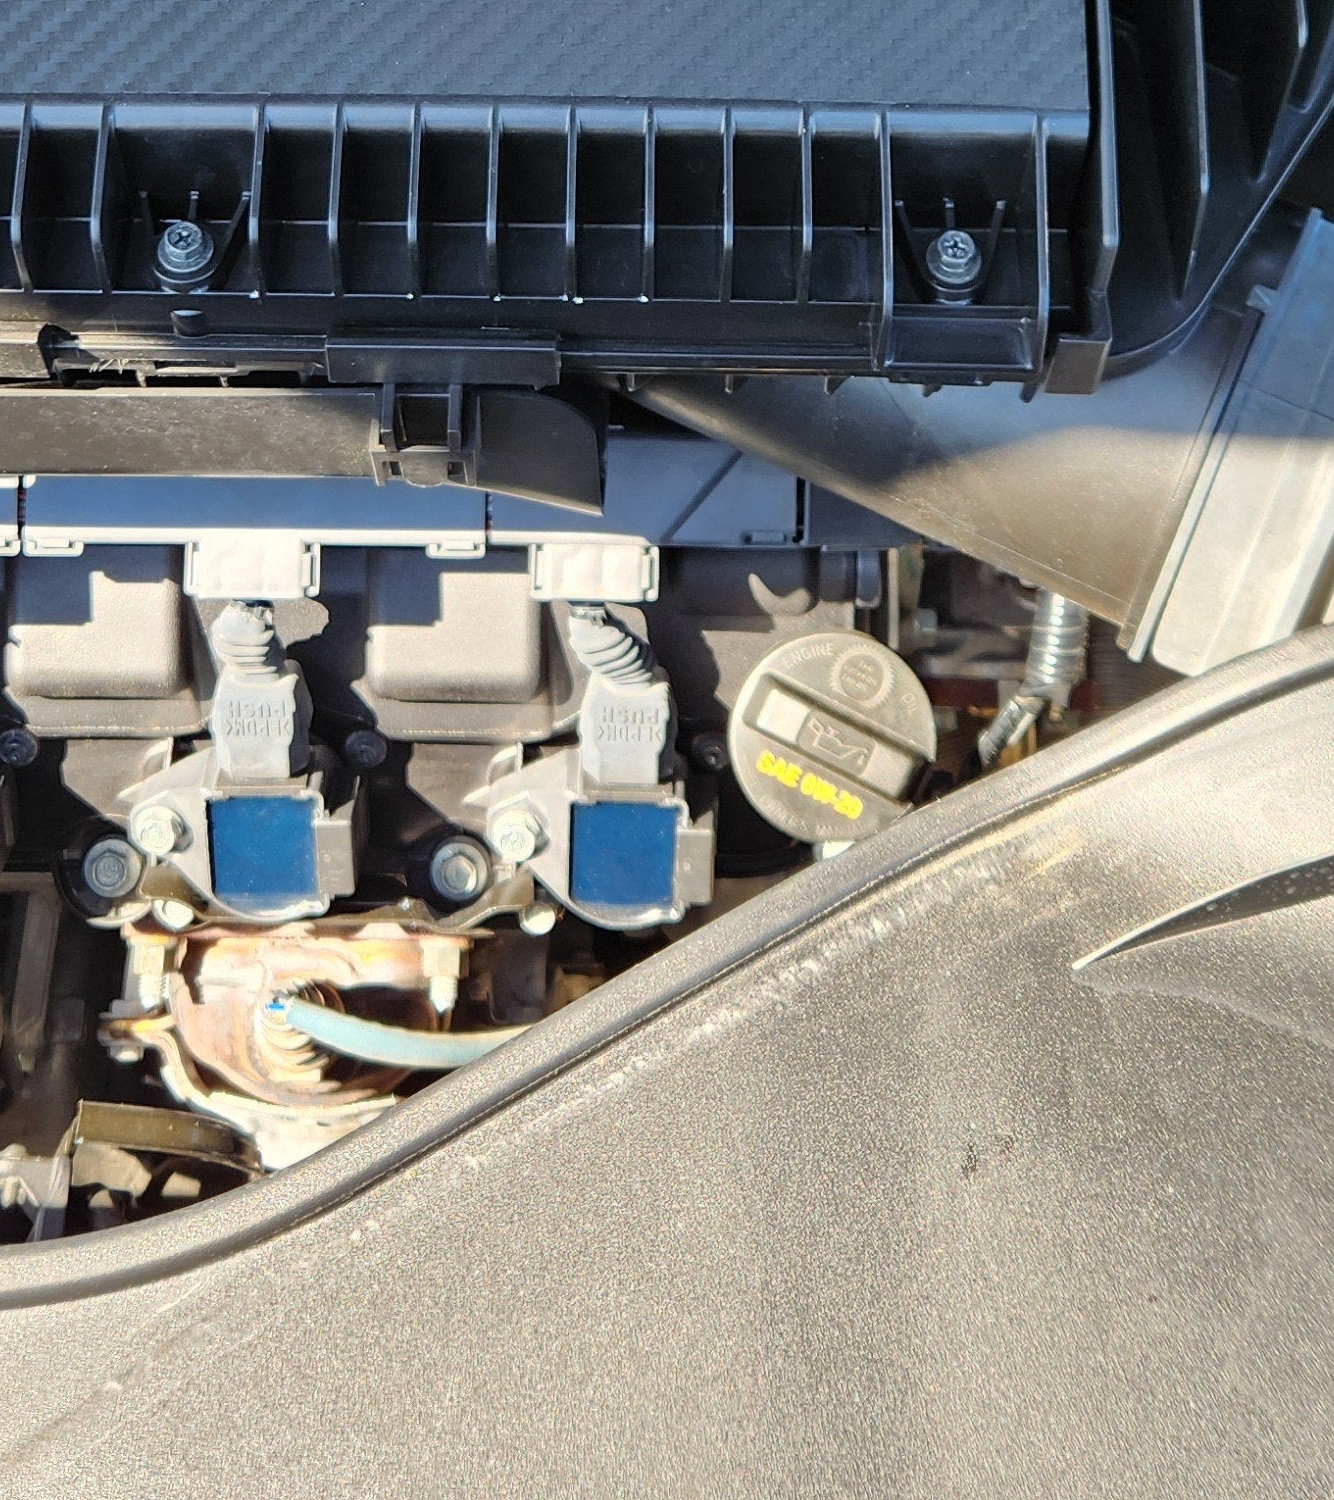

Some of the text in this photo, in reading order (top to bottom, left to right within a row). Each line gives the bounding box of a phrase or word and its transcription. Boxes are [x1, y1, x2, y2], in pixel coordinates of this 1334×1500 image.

[780, 642, 920, 717] ENGINE OIL
[228, 699, 286, 719] PUSH
[601, 706, 661, 724] PUSH
[755, 749, 802, 789] SAE
[800, 772, 865, 821] 0W-20
